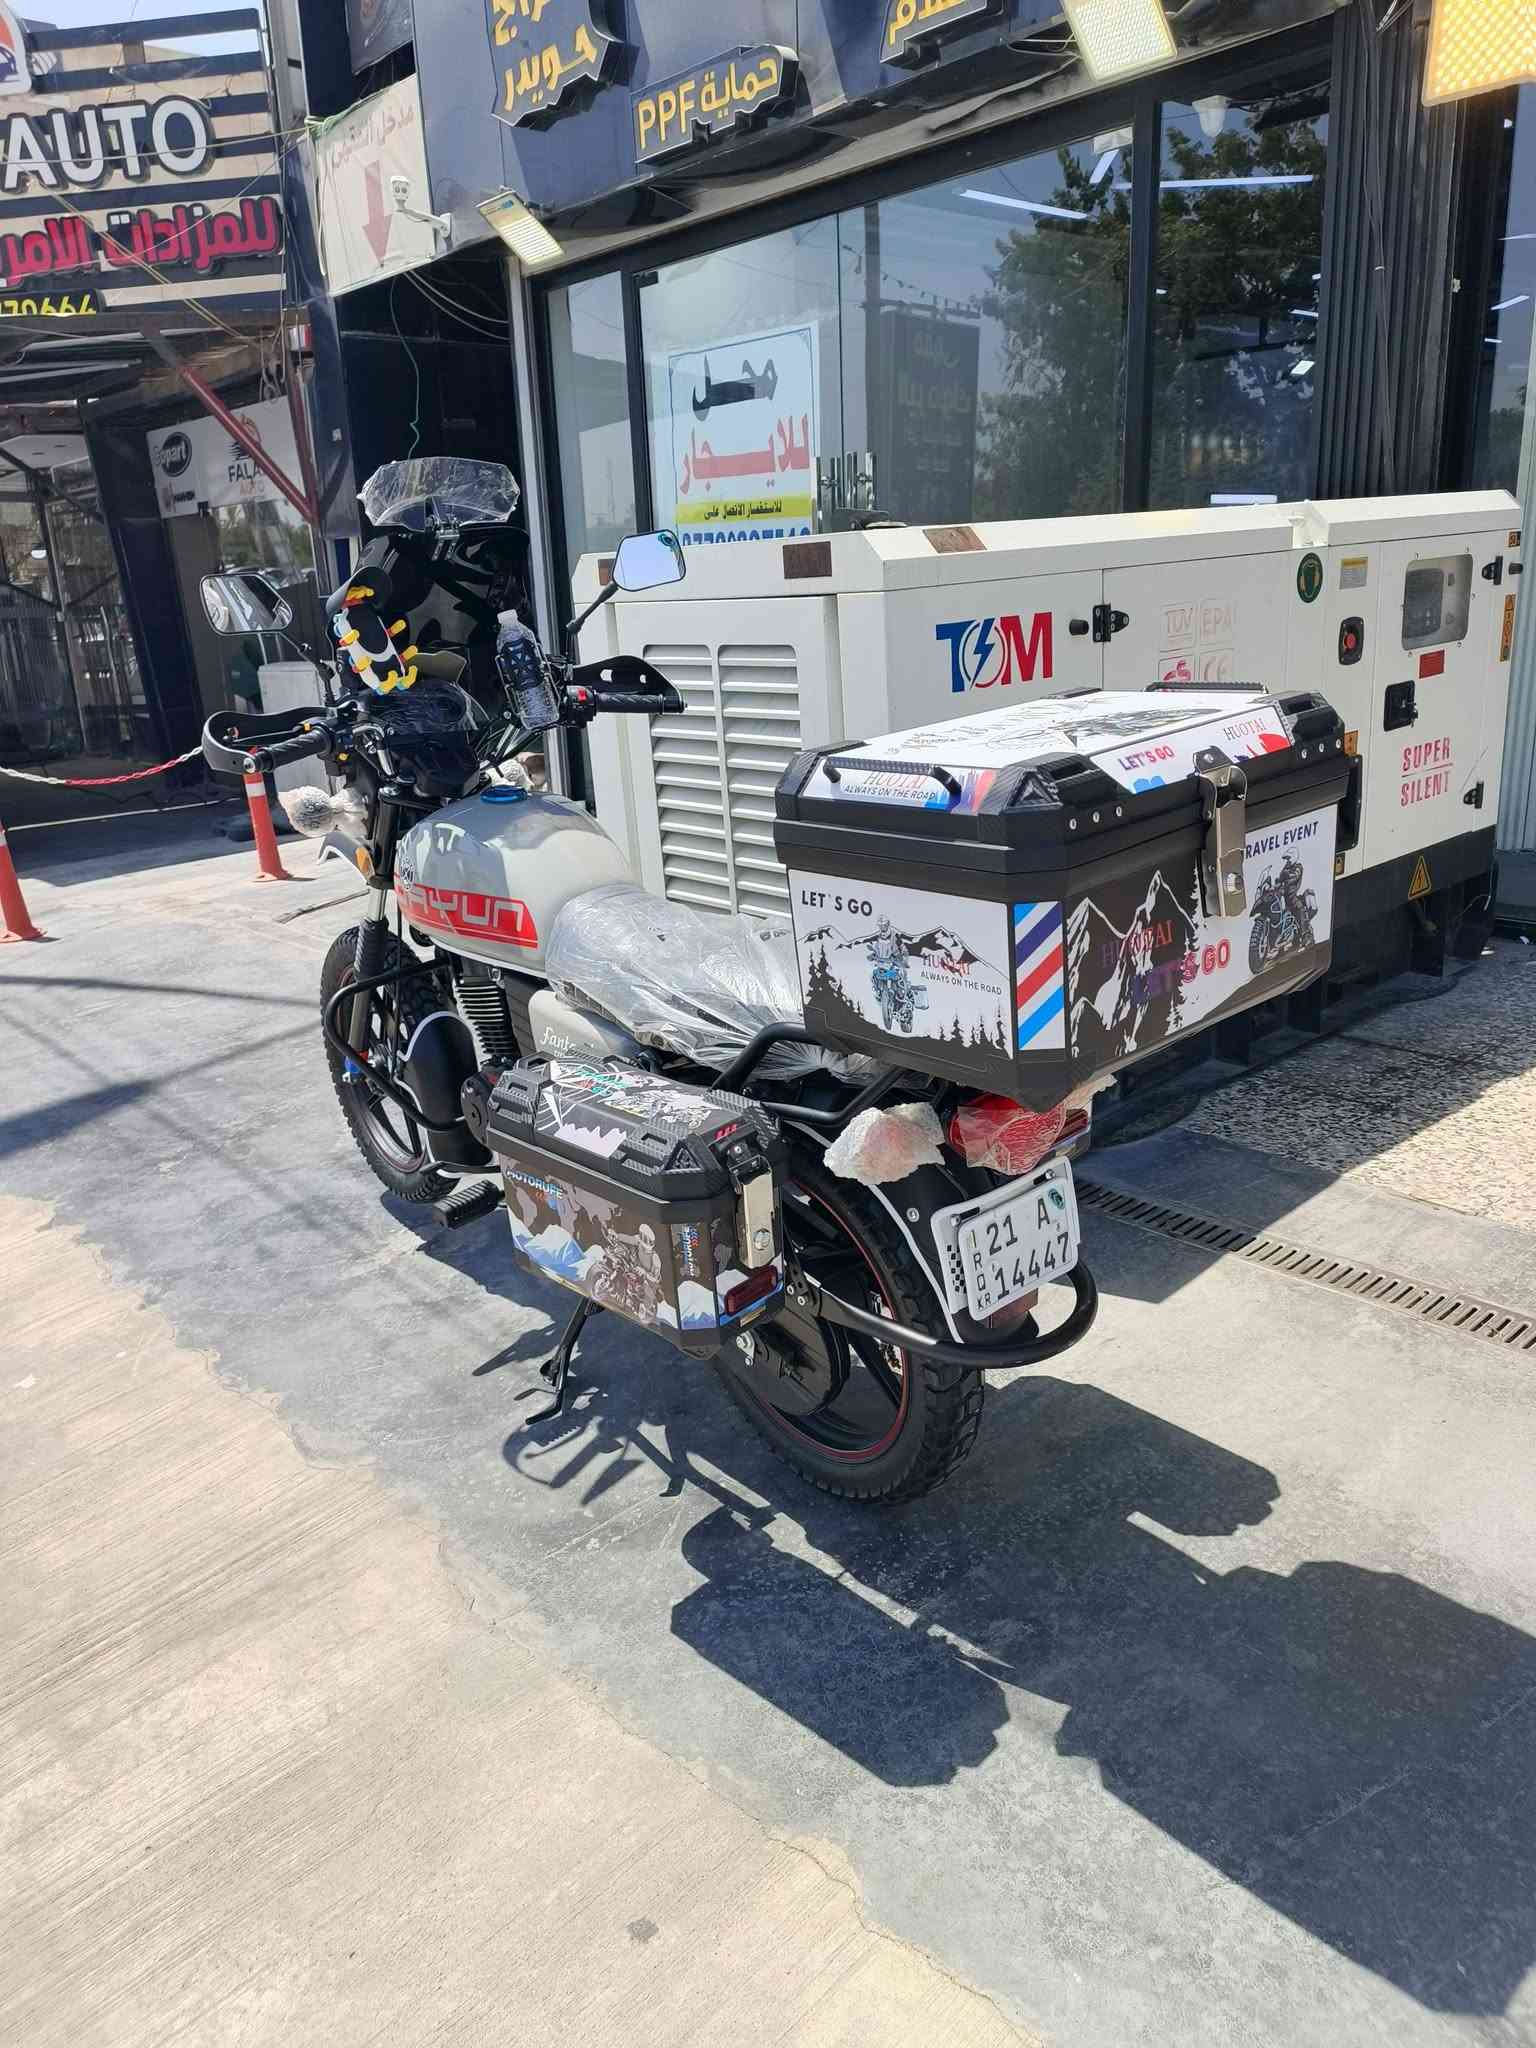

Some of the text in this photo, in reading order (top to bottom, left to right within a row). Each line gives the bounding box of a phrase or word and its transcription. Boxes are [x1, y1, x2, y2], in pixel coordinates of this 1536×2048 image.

[638, 57, 778, 150] حماية PPF
[4, 99, 207, 190] AUTO
[103, 196, 282, 271] للمزادات
[692, 353, 778, 422] محل
[679, 413, 810, 495] للايجار
[935, 611, 1053, 692] TOM
[1223, 717, 1266, 741] HUOTAI
[1117, 742, 1176, 771] LET'S GO
[1402, 736, 1452, 772] SUPER
[844, 785, 937, 801] ALWAYS ON THE ROAD
[1400, 770, 1451, 807] SILENT
[1245, 820, 1320, 860] RAVEL EVENT
[847, 898, 874, 917] GO
[1201, 937, 1231, 976] GO
[920, 969, 1002, 997] ALWAYS ON THE ROAD
[986, 1198, 1050, 1255] 21 A
[994, 1231, 1069, 1301] 14447
